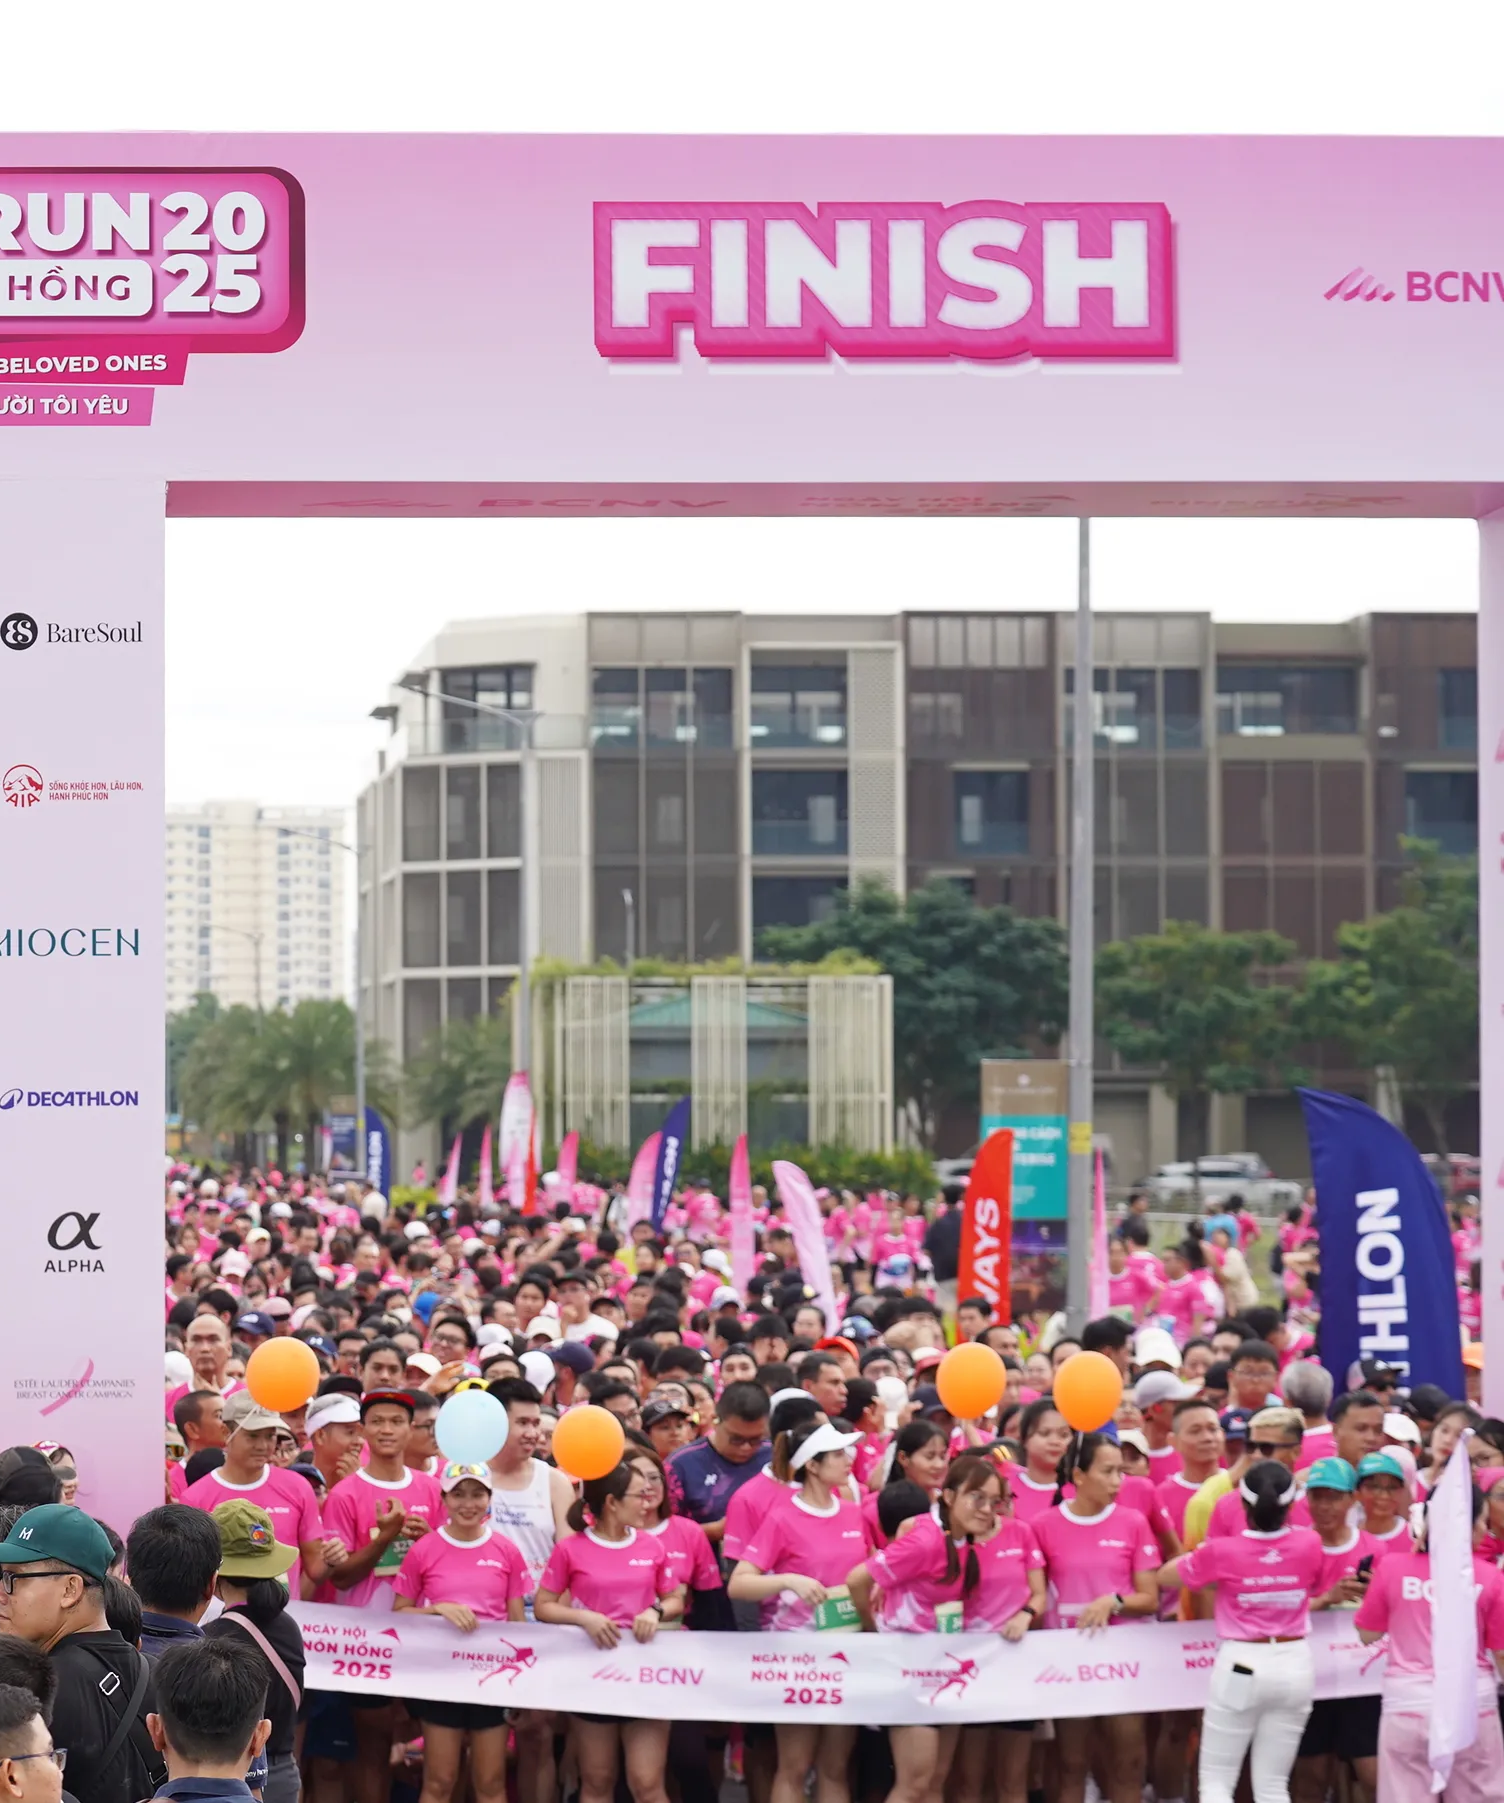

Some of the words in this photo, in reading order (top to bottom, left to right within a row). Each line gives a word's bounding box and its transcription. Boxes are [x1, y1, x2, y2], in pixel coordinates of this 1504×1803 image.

[159, 191, 266, 253] 20
[610, 216, 1151, 331] FINISH
[7, 265, 133, 303] HỒNG
[160, 253, 262, 315] 25
[103, 352, 169, 374] ONES
[39, 395, 79, 416] TÔI
[84, 395, 130, 416] YÊU
[47, 621, 143, 643] BareSoul
[5, 792, 41, 808] AIA
[27, 1090, 139, 1107] DECATHLON
[44, 1259, 105, 1273] ALPHA
[302, 1623, 340, 1637] NGÀY
[341, 1626, 368, 1640] HỘI
[303, 1638, 340, 1655] NÓN
[342, 1640, 394, 1660] HỒNG
[452, 1650, 517, 1664] PINKRUN
[752, 1652, 787, 1664] NGÀY
[791, 1653, 816, 1666] HỘI
[332, 1658, 392, 1680] 2025
[639, 1666, 705, 1686] BCNV
[751, 1668, 789, 1682] NÓN
[794, 1665, 843, 1683] HỒNG
[1077, 1661, 1141, 1683] BCNV
[783, 1687, 844, 1705] 2025
